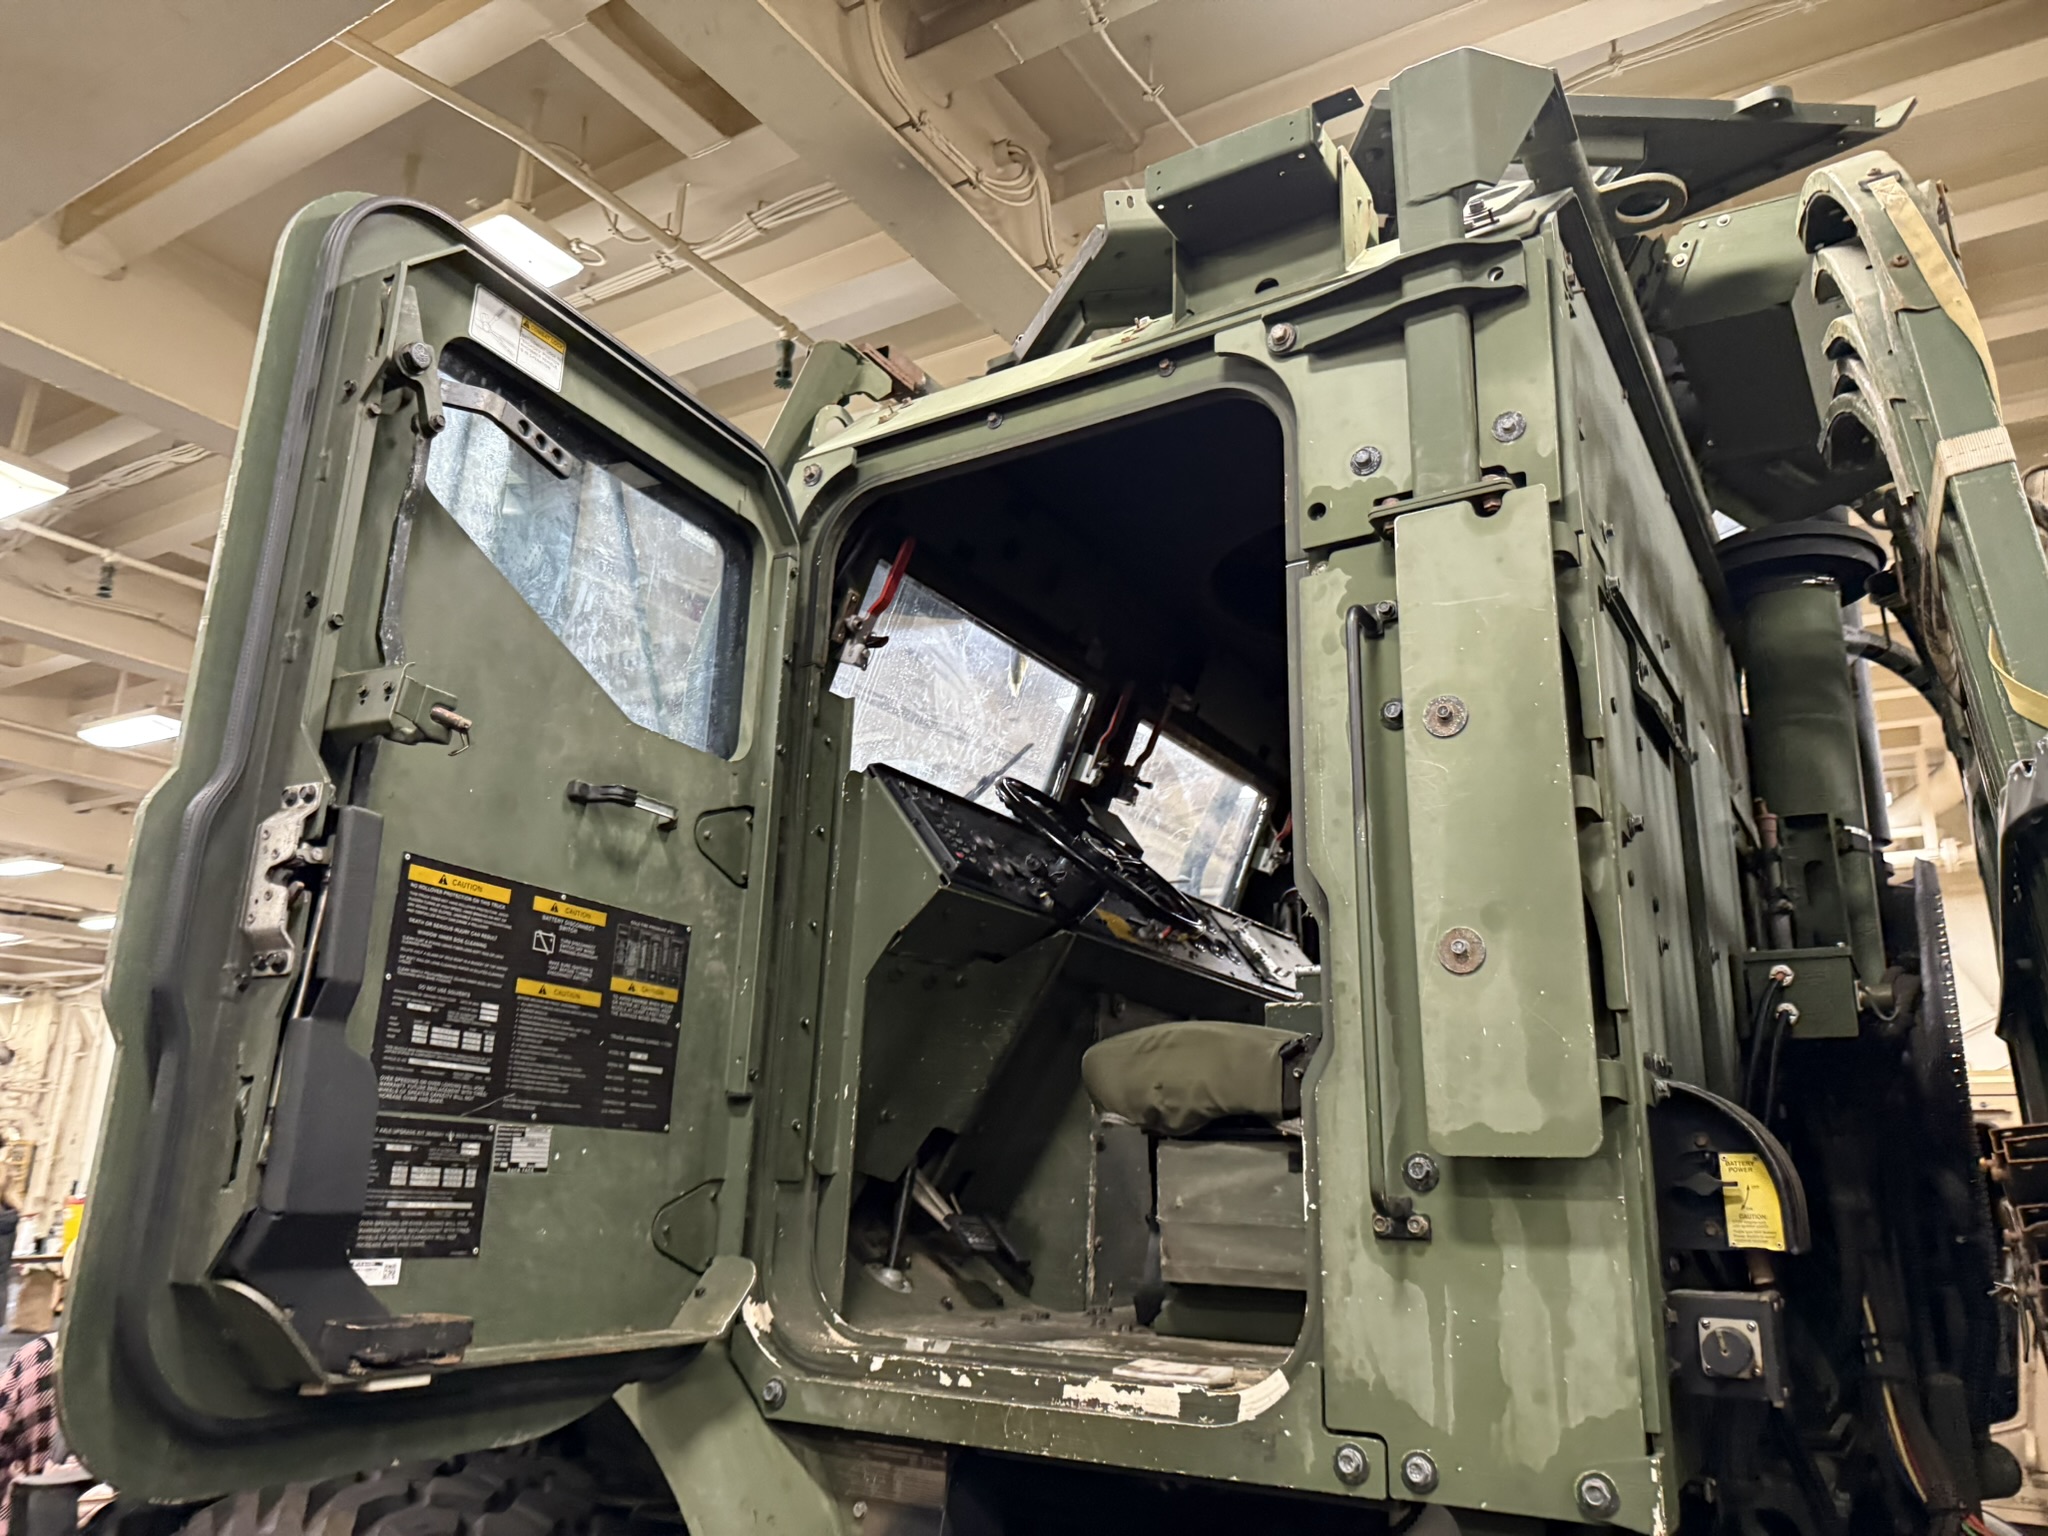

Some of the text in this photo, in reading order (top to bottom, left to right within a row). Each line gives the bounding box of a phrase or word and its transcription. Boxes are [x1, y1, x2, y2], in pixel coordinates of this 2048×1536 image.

[452, 879, 482, 892] CAUTION
[564, 907, 591, 919] CAUTION
[554, 988, 581, 999] CAUTION
